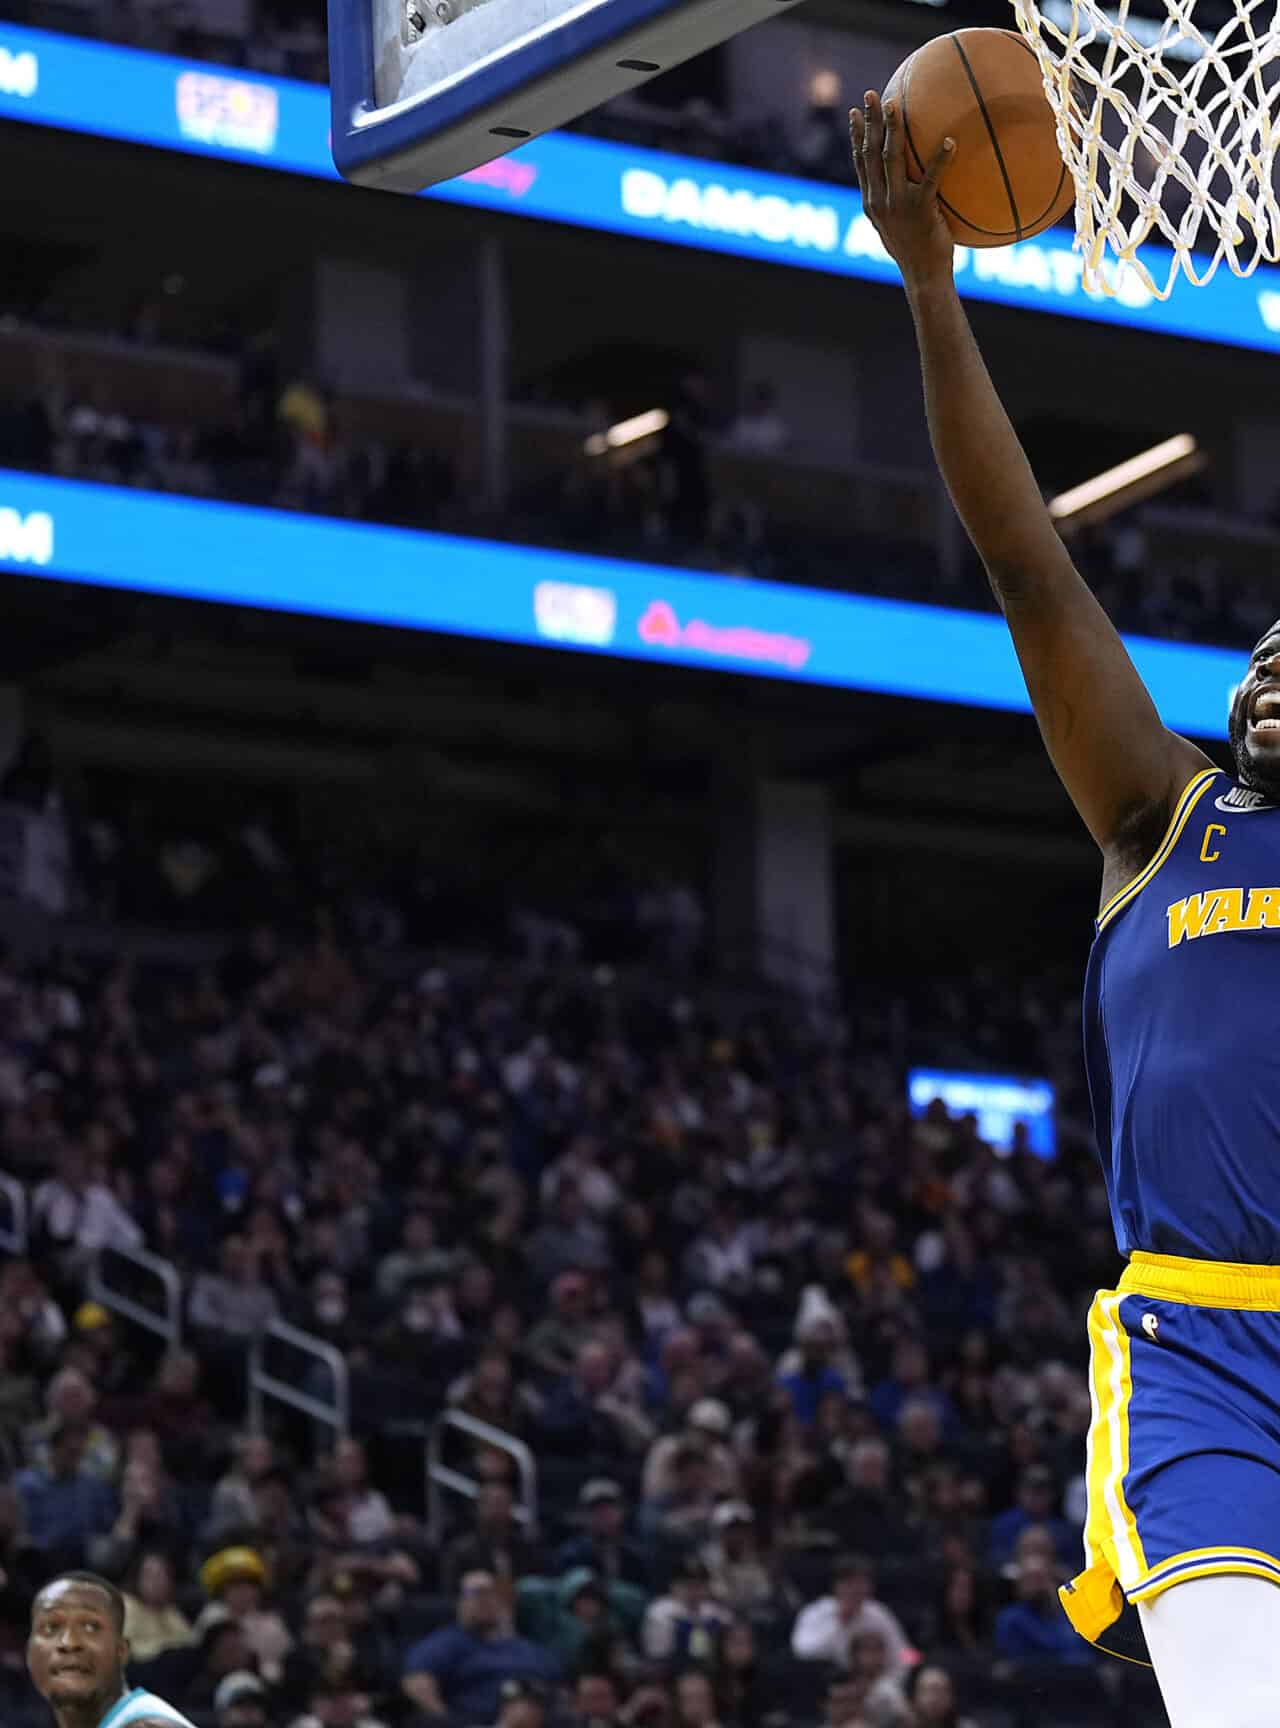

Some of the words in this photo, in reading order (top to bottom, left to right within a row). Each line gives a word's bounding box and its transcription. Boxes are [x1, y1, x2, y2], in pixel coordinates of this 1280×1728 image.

[620, 168, 839, 252] DAMON
[1223, 786, 1265, 808] NIKE
[1199, 823, 1227, 862] C
